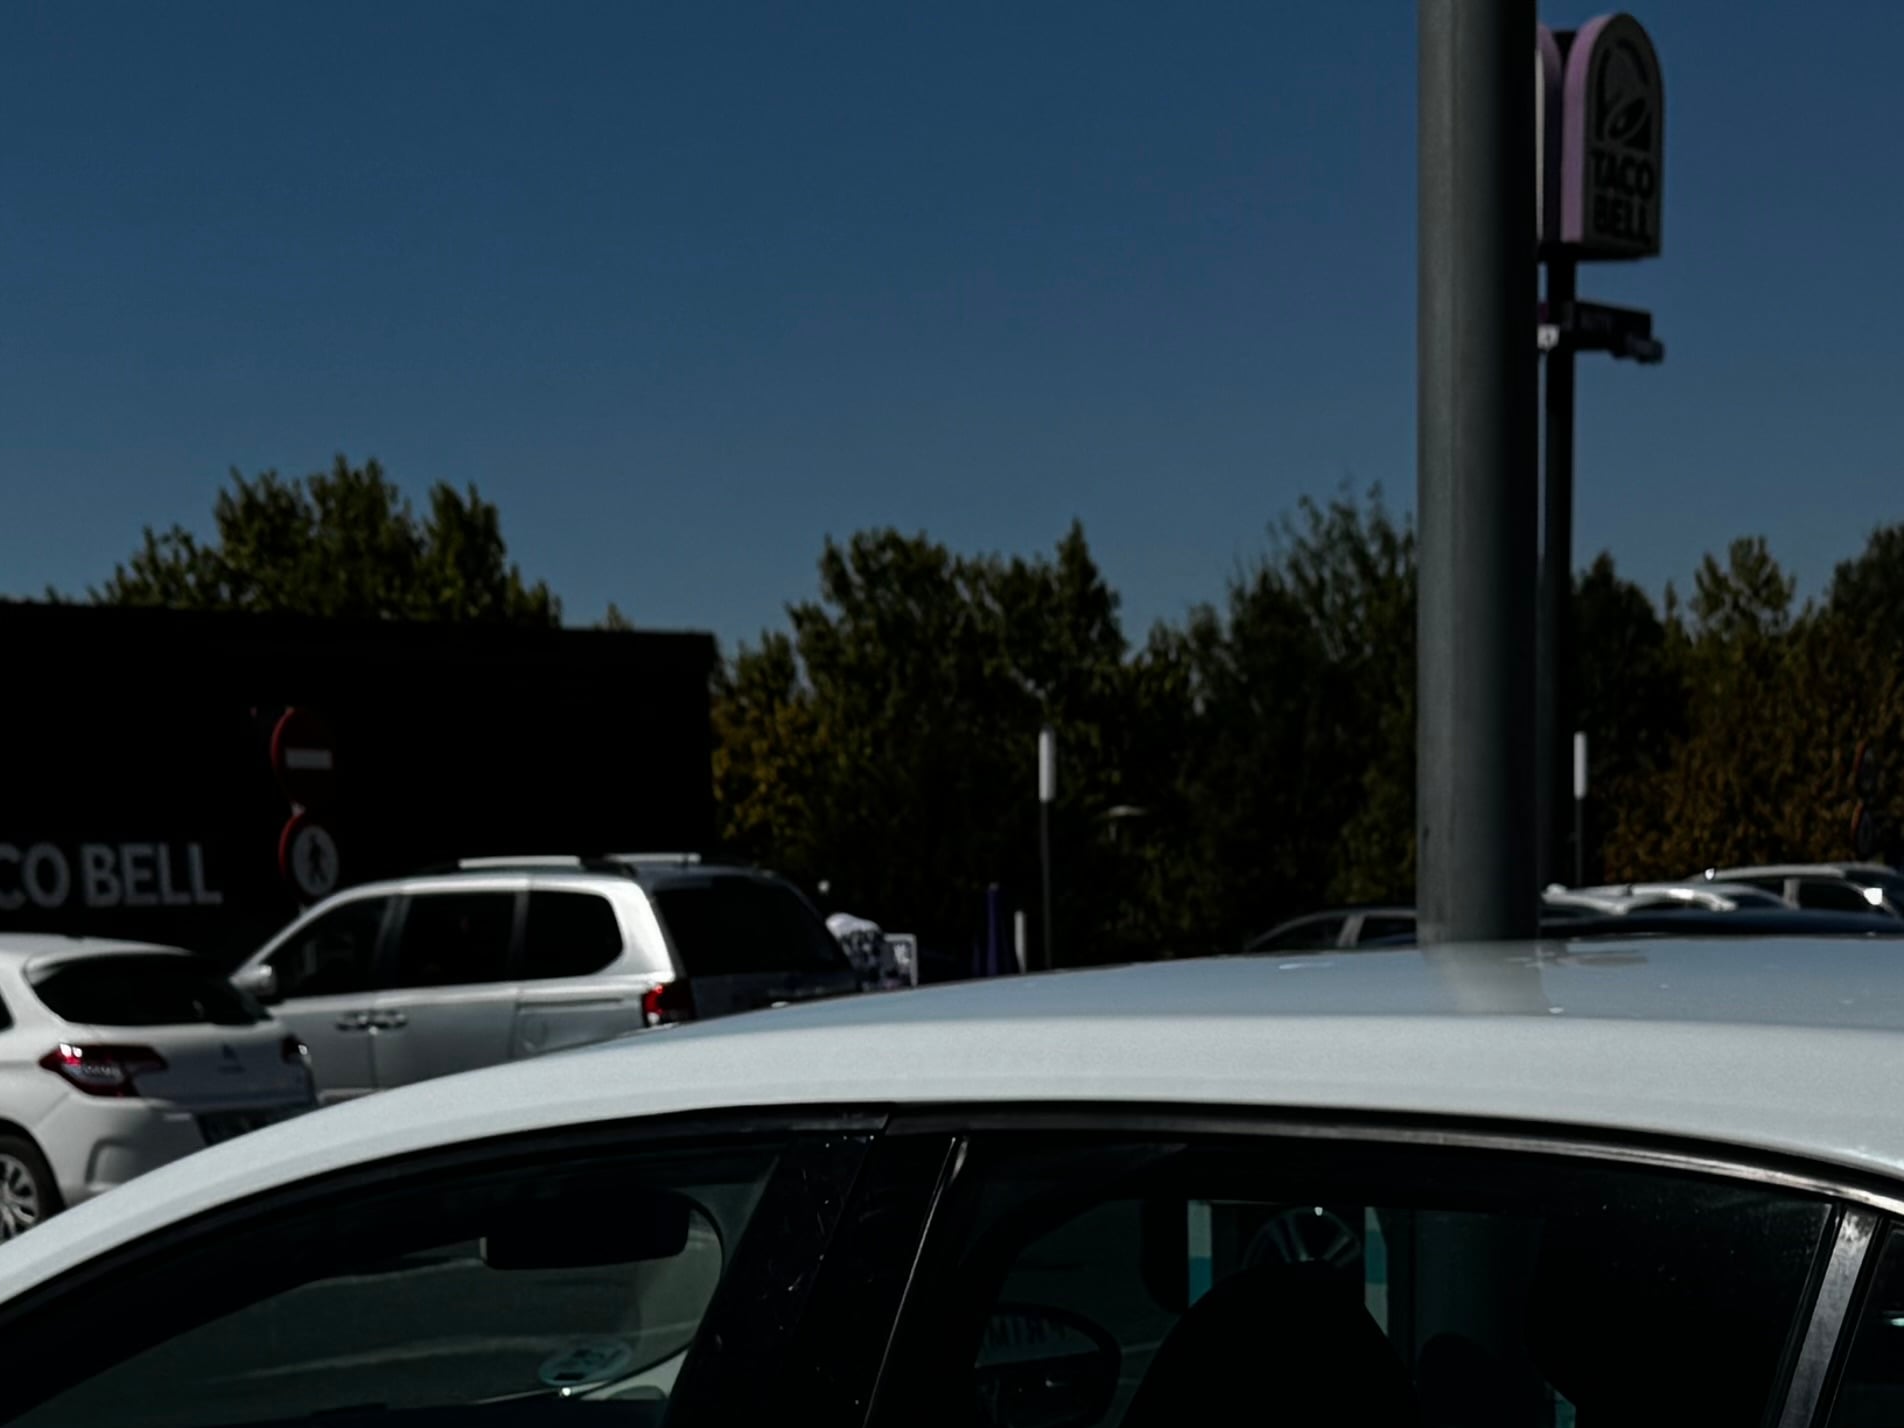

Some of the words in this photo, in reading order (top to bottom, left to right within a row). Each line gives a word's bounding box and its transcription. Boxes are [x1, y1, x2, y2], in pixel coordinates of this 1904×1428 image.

[1590, 149, 1654, 198] TACO
[1595, 194, 1651, 246] BELL
[80, 840, 225, 907] BELL
